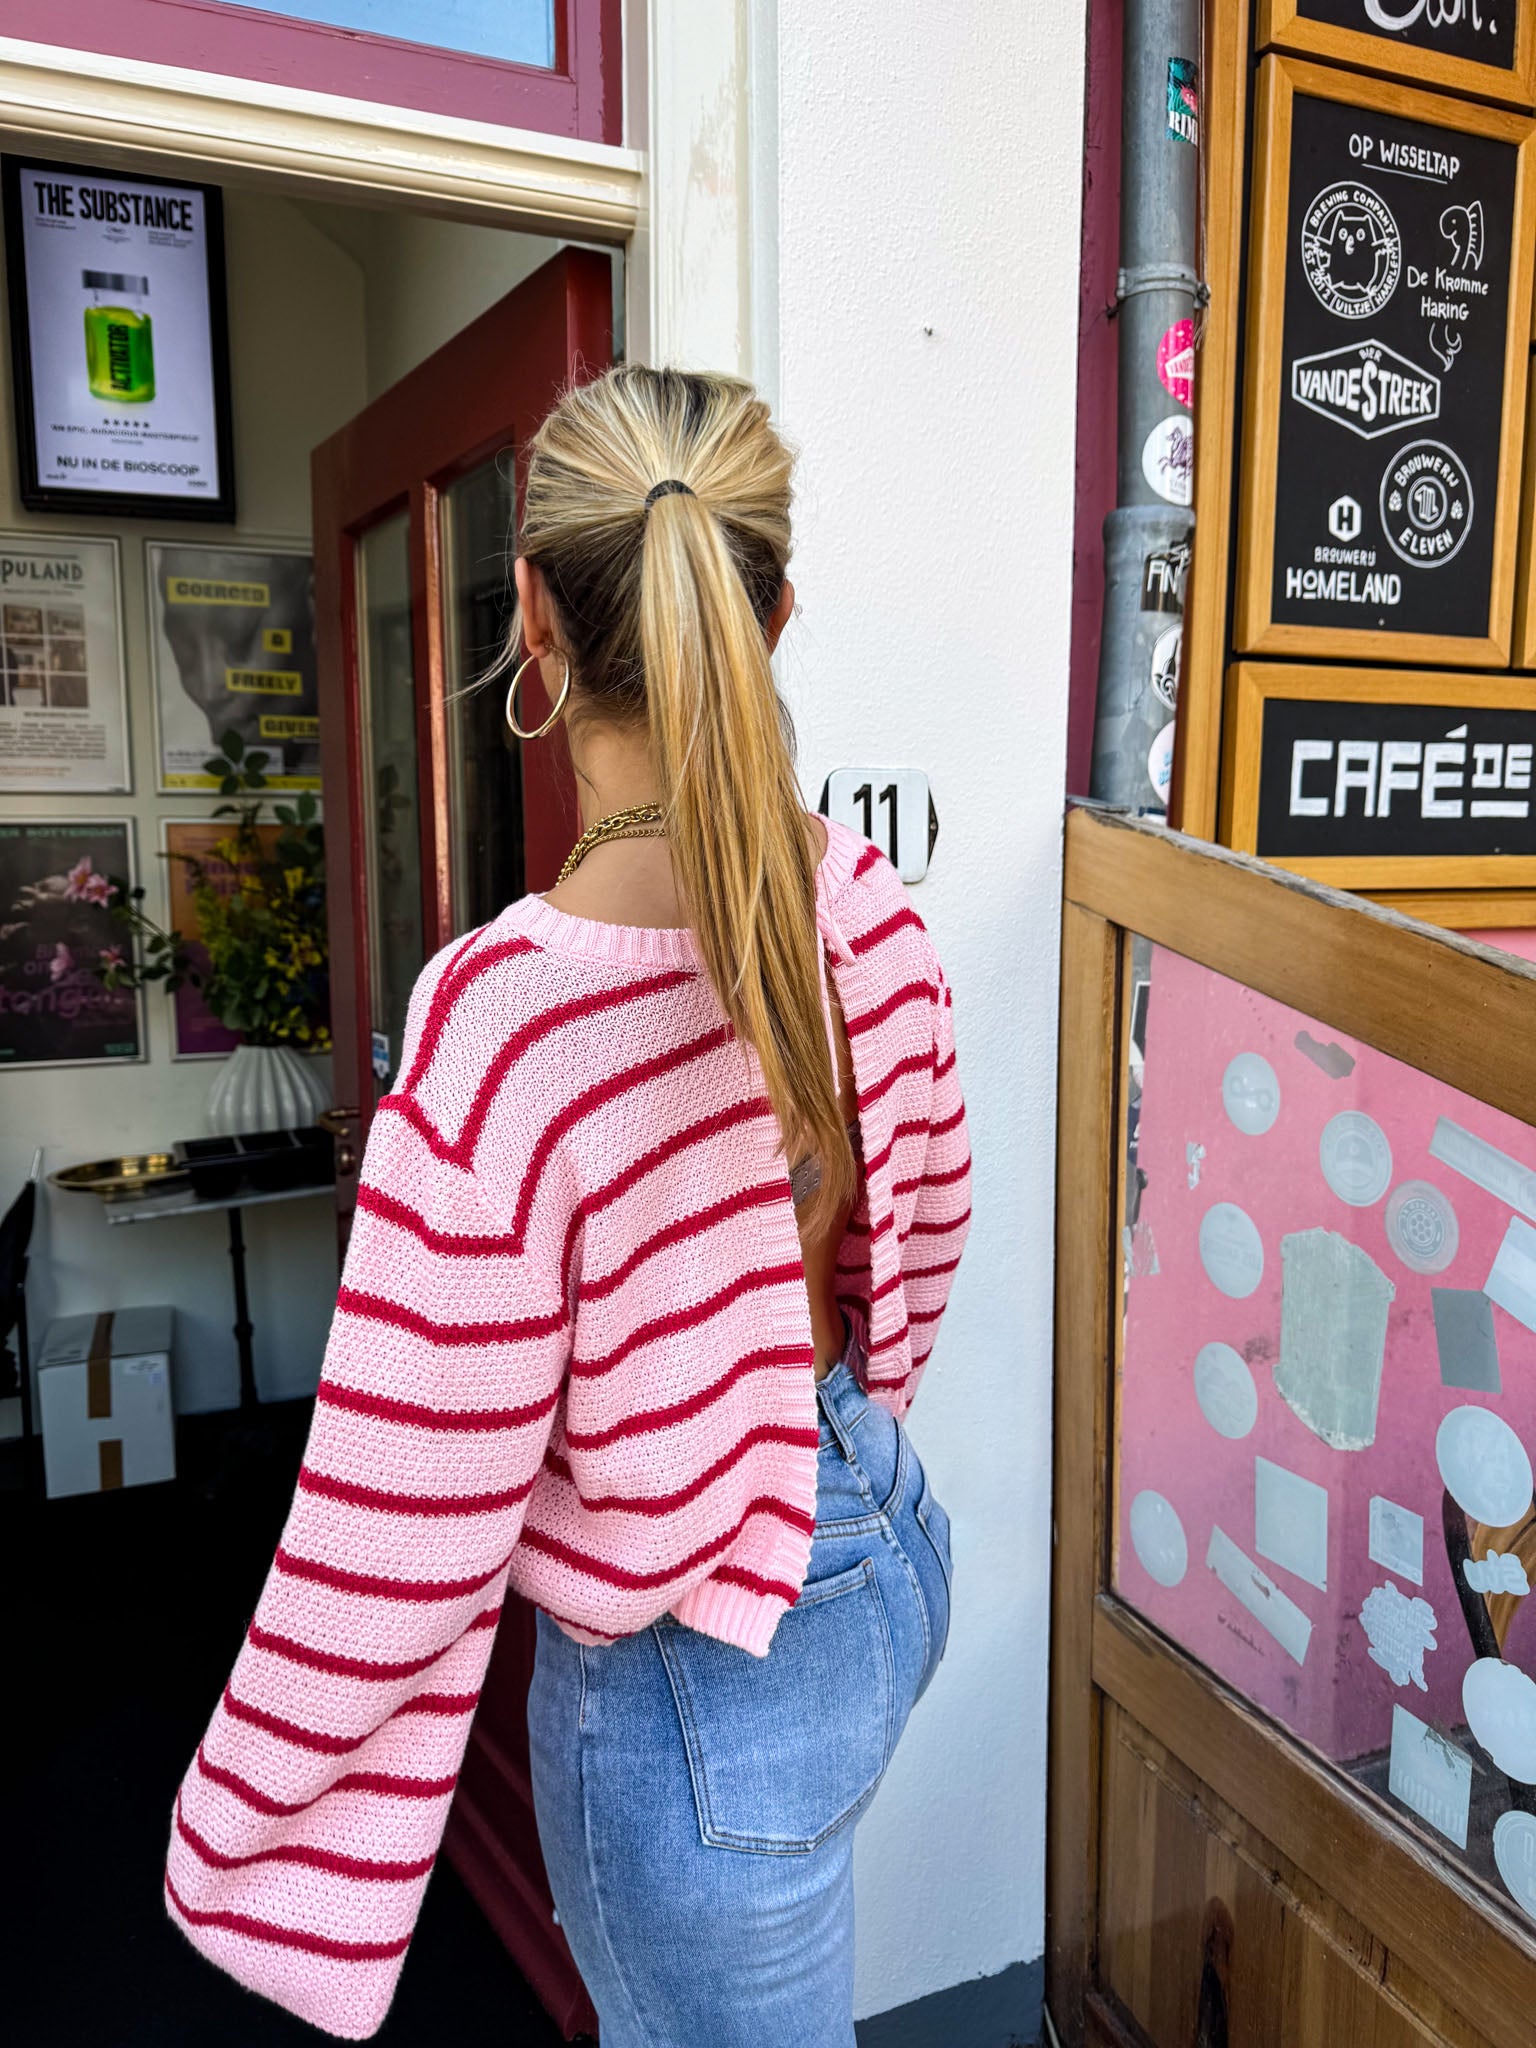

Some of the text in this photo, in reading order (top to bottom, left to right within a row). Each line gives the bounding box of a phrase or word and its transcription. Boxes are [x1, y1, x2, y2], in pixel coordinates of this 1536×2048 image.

[1348, 133, 1460, 180] OP WISSELTAP
[33, 181, 194, 232] THE SUBSTANCE
[1309, 190, 1395, 235] BREWING COMPANY
[1309, 268, 1332, 301] 2012
[1373, 243, 1399, 305] HAARLEM
[1407, 265, 1429, 288] De
[1335, 298, 1372, 316] UILTJE
[1358, 347, 1383, 363] BIER
[1299, 359, 1435, 423] VANDESTREEK
[56, 455, 200, 477] NU IN DE BIOSCOOP
[1399, 527, 1454, 556] ELEVEN
[175, 582, 266, 603] COERCED
[1285, 566, 1402, 605] HOMELAND
[231, 672, 298, 692] FREELY
[1288, 723, 1533, 819] CAFÉ DE
[853, 783, 898, 869] 11
